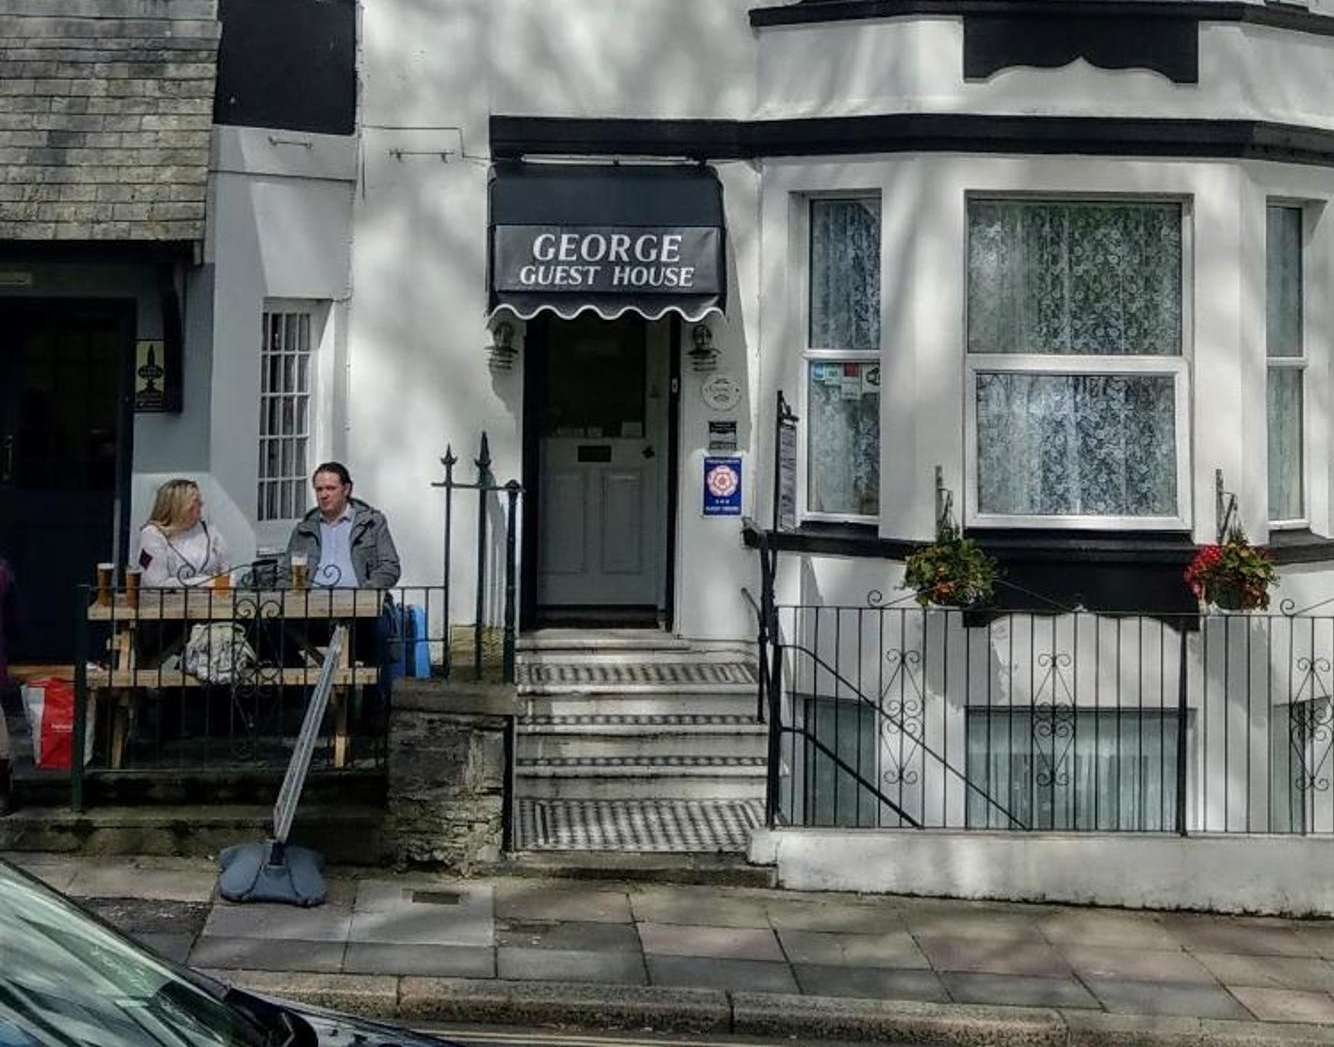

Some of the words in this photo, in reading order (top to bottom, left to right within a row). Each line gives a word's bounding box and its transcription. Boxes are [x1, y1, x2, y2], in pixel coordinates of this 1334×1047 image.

[532, 233, 683, 263] GEORGE
[519, 265, 601, 286] GUEST
[612, 266, 695, 288] HOUSE
